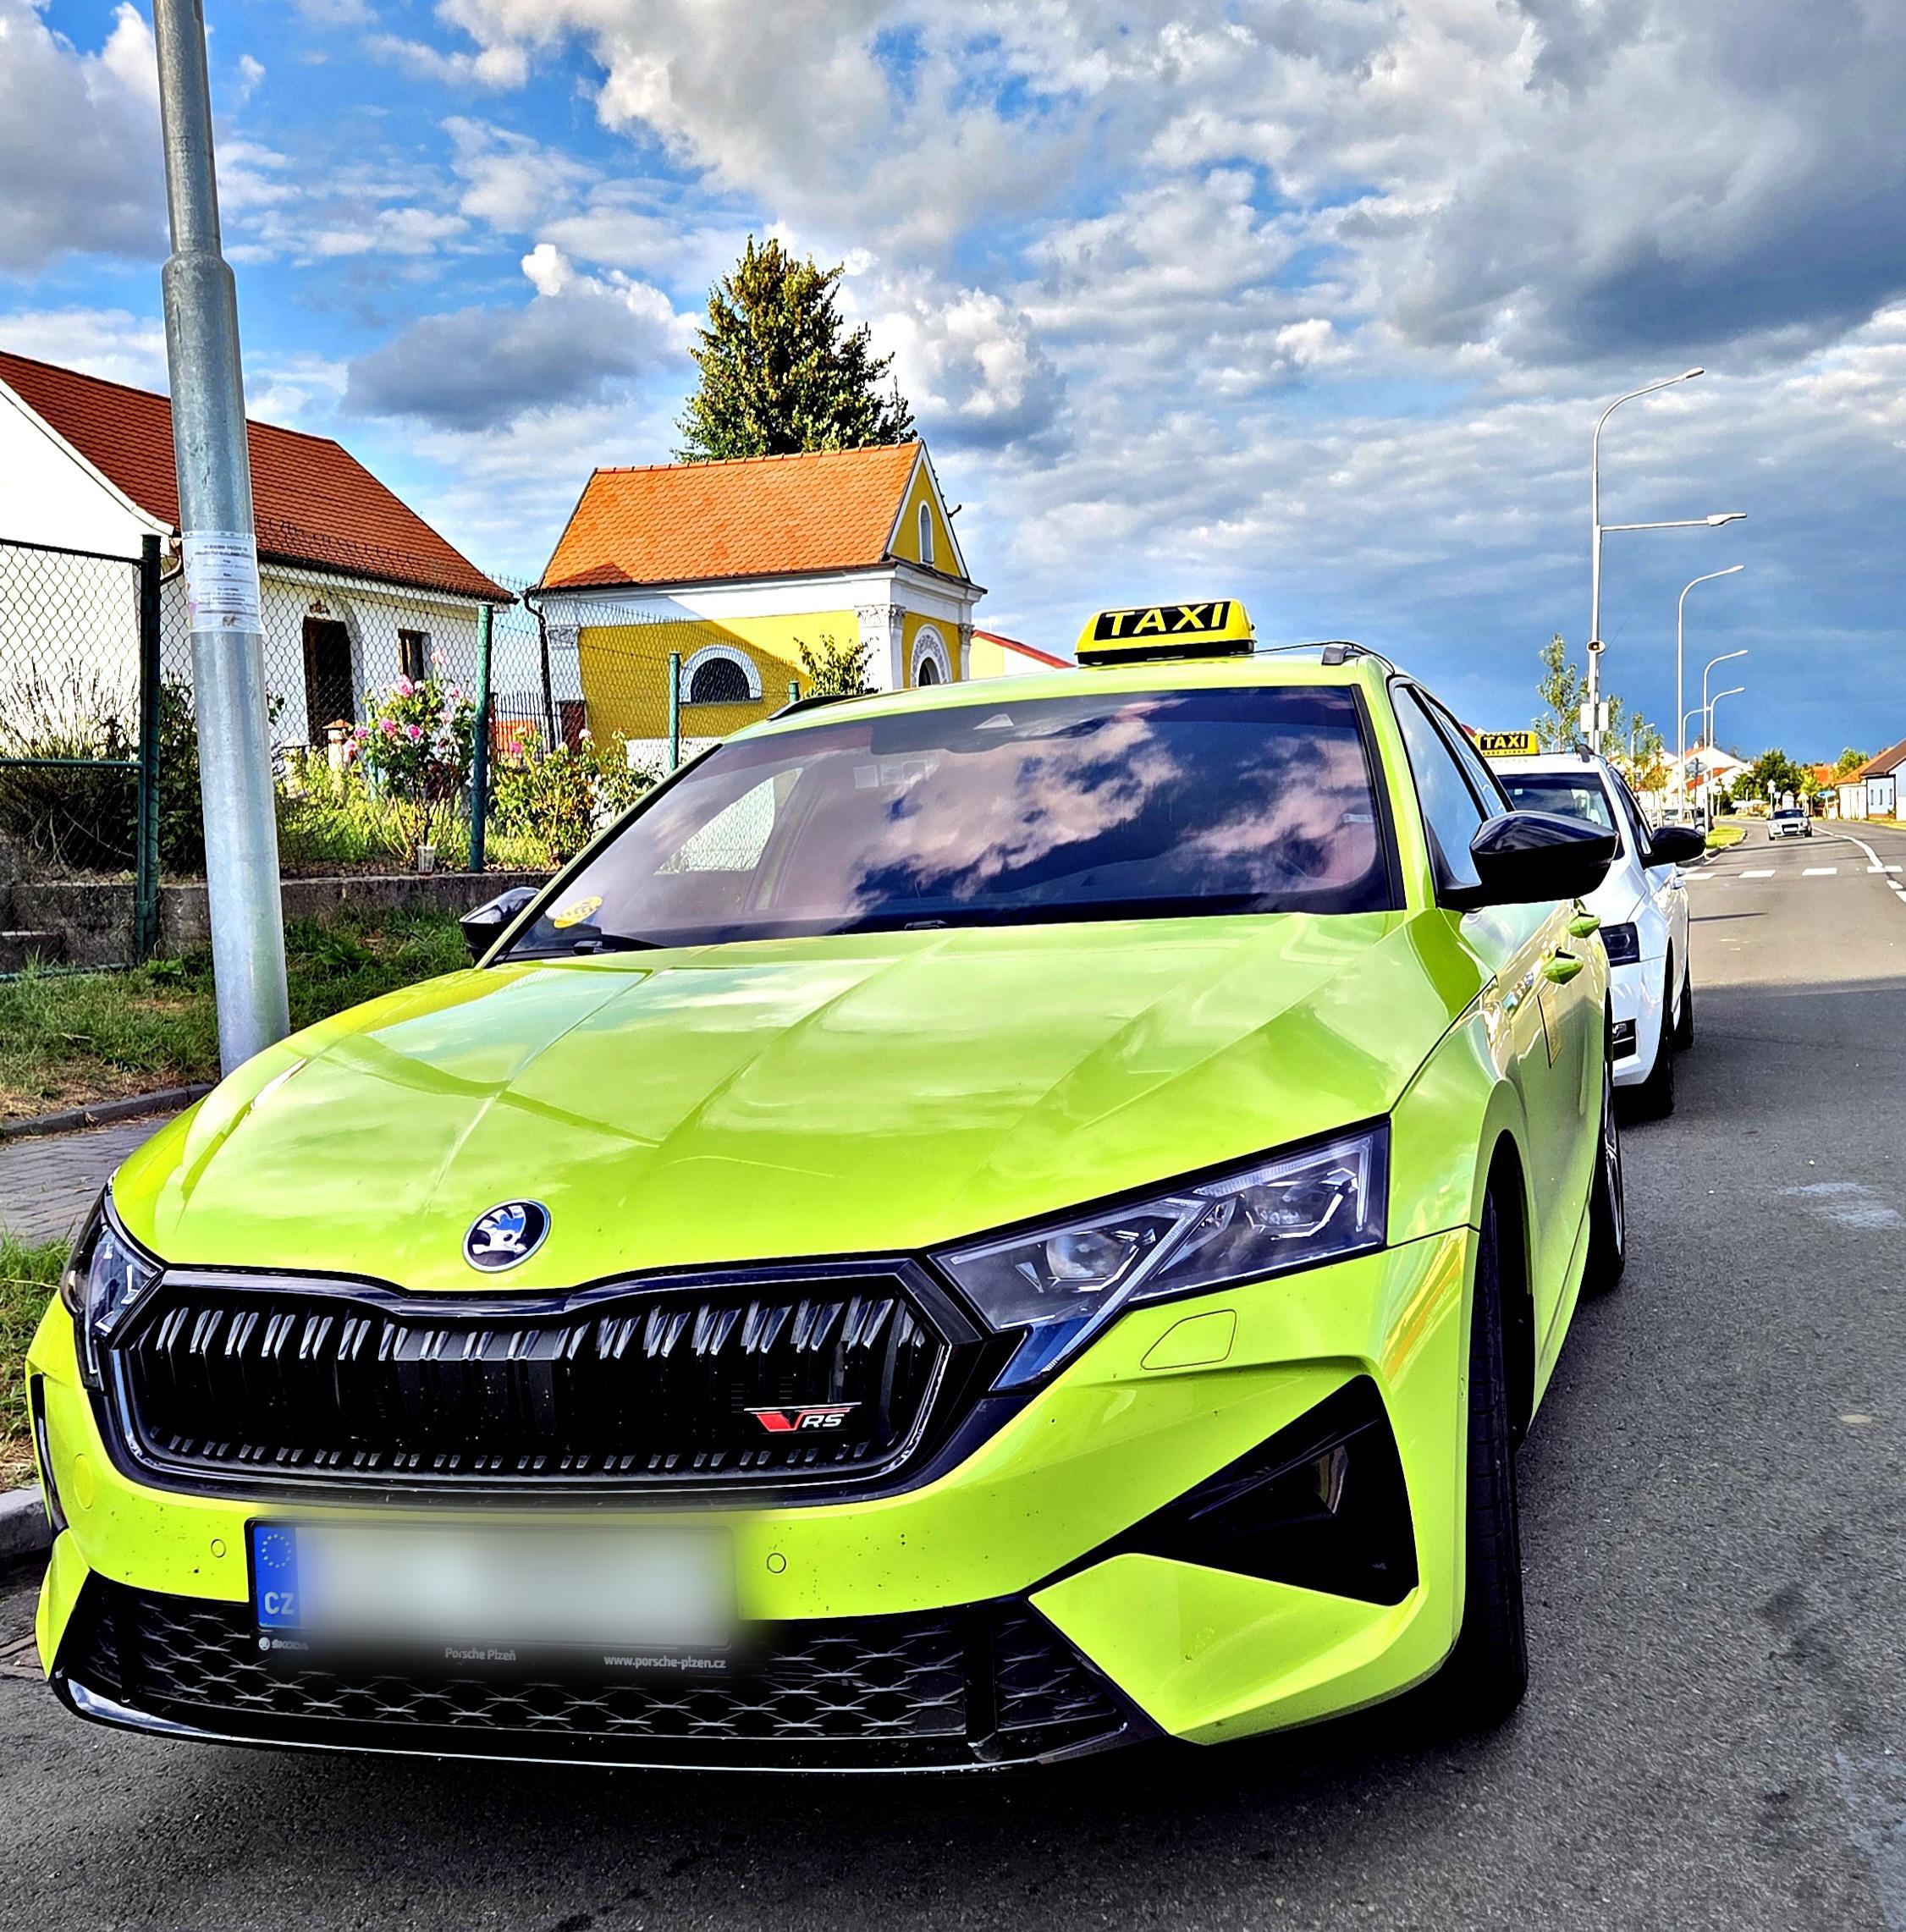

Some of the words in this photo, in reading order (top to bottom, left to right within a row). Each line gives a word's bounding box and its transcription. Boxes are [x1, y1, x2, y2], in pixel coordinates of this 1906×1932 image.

[1105, 603, 1224, 636] TAXI
[1483, 735, 1525, 749] TAXI
[264, 1591, 295, 1616] CZ
[444, 1647, 485, 1660] Porsche
[487, 1648, 516, 1661] Plzeň
[603, 1654, 727, 1671] www.porsche-plzen.cz
